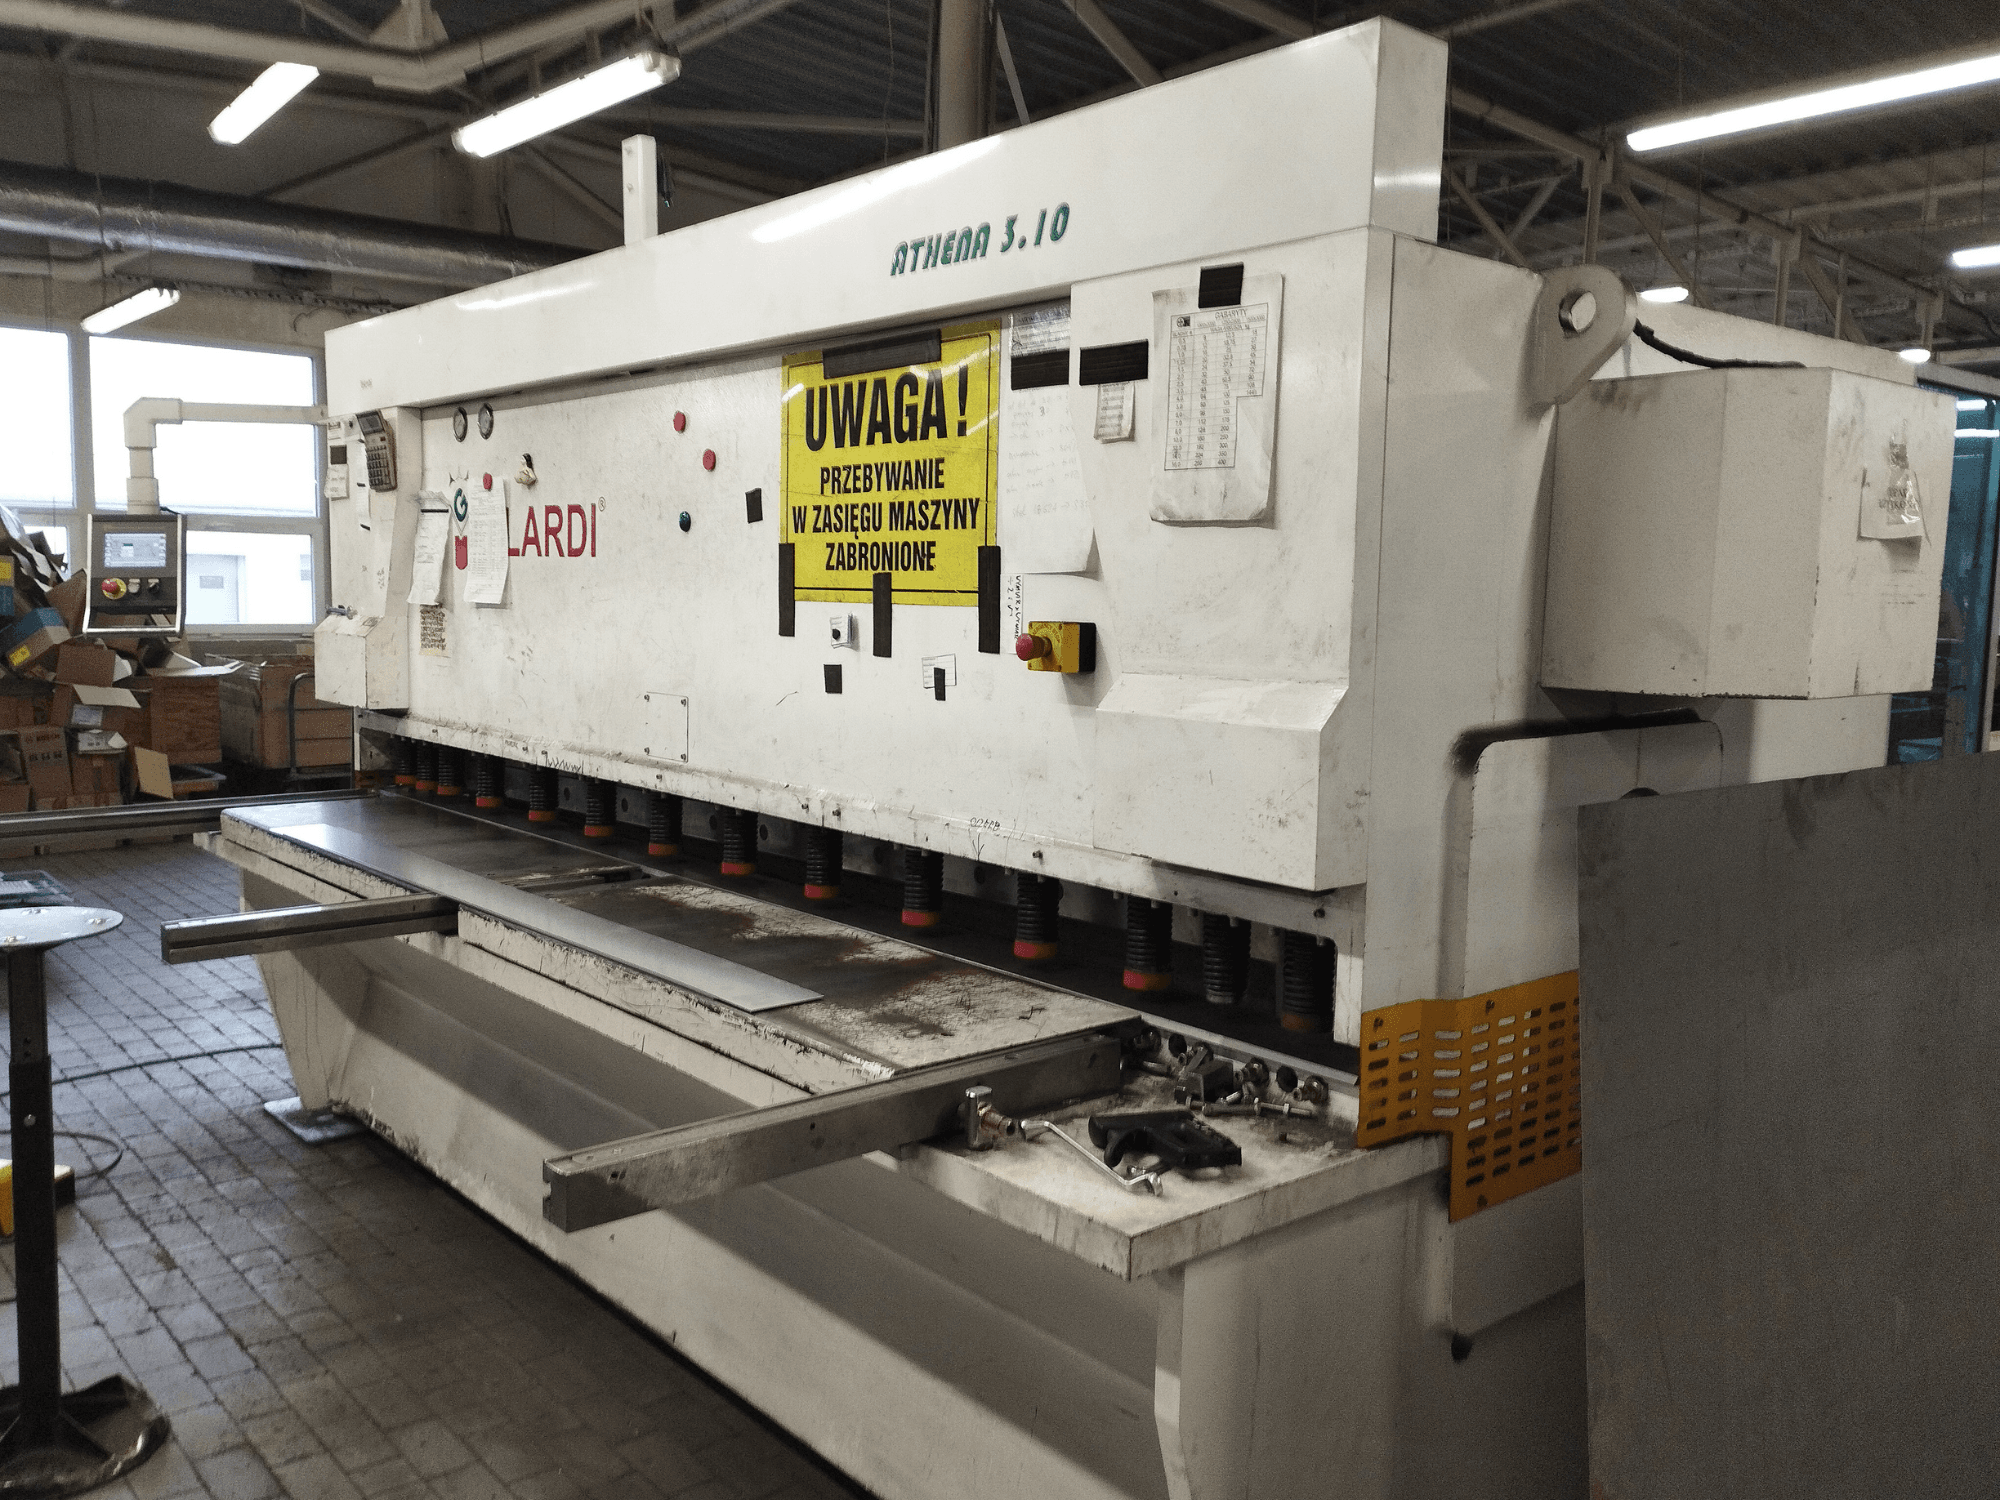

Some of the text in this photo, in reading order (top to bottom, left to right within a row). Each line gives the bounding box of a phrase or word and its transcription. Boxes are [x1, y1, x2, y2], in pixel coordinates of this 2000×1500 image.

[890, 222, 991, 276] ATHENA
[820, 457, 945, 495] PRZEBYWANIE
[792, 498, 980, 540] W ZASIĘGU MASZYNY
[825, 540, 936, 571] ZABRONIONE
